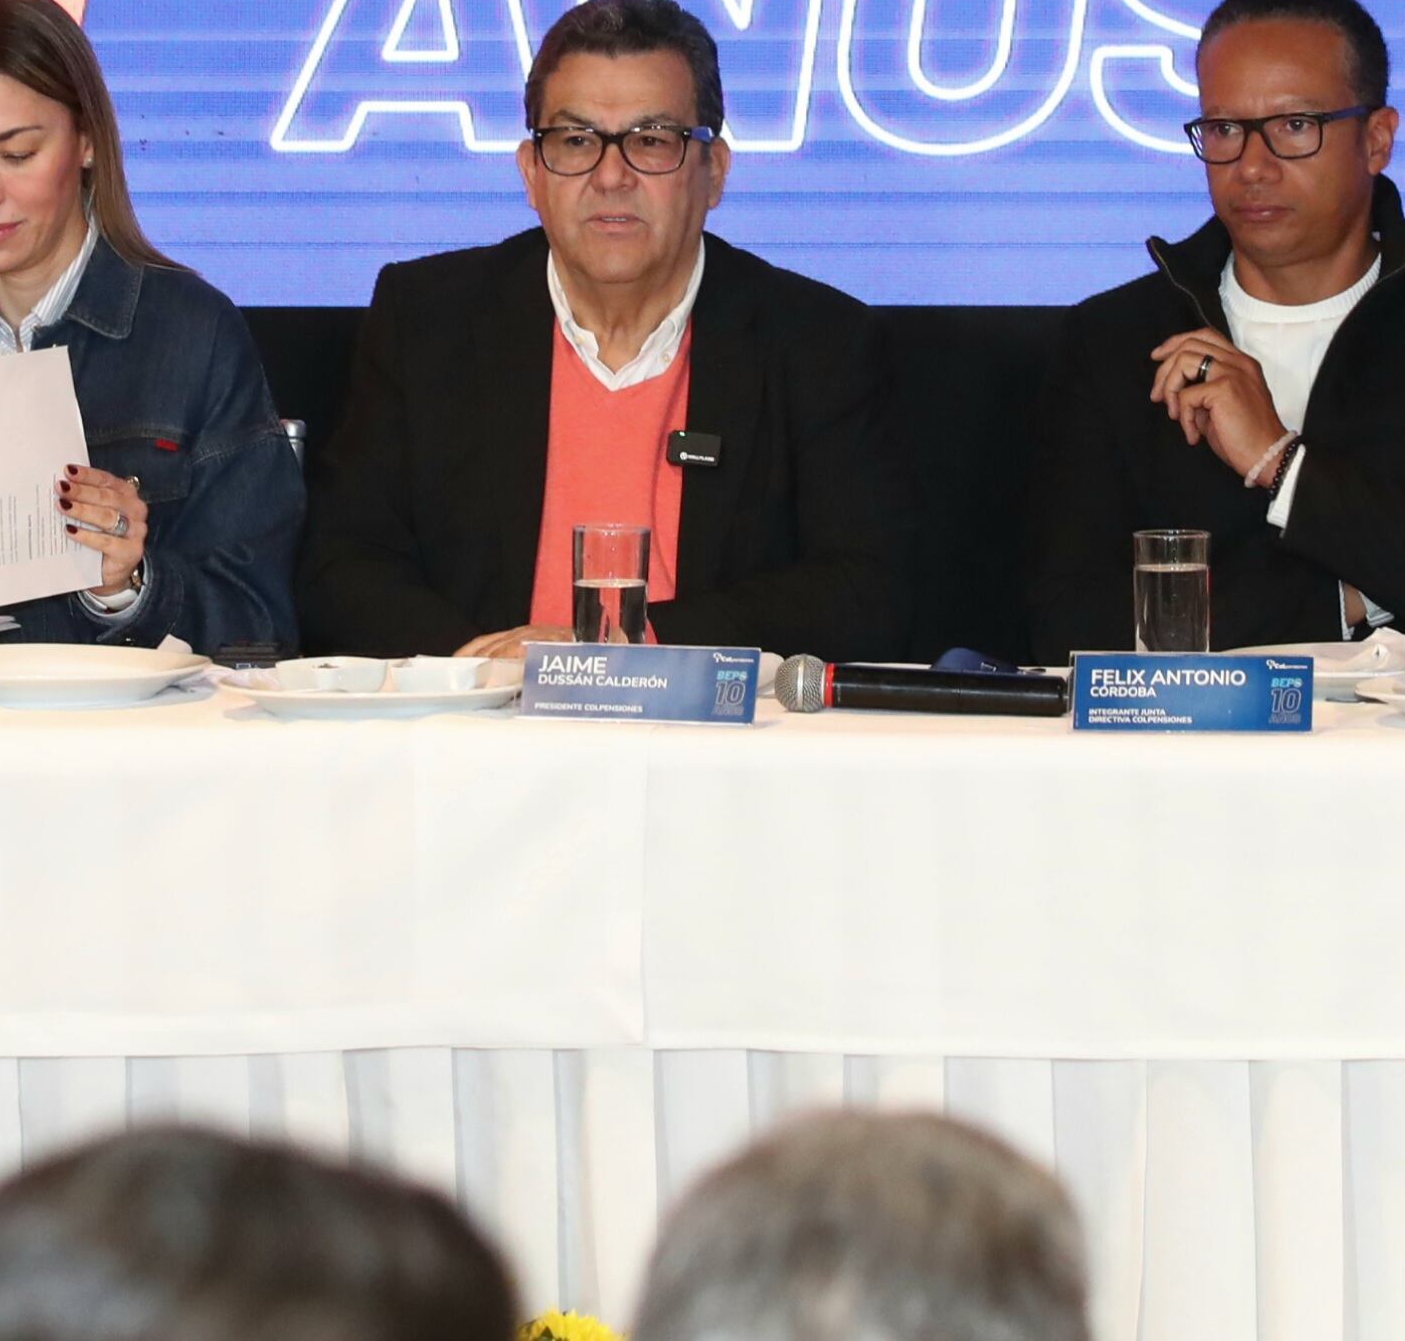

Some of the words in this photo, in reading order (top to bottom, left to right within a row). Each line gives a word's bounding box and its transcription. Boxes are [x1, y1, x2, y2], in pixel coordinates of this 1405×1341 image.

[538, 655, 608, 674] JAIME
[537, 672, 593, 686] DUSSÁN
[596, 673, 668, 689] CALDERÓN
[1091, 669, 1146, 685] FELIX
[1150, 670, 1246, 686] ANTONIO
[715, 681, 746, 706] 10
[1270, 688, 1302, 713] 10
[534, 702, 583, 711] PRESIDENTE
[584, 704, 643, 713] COLPENSIONES
[1088, 708, 1140, 716] INTEGRANTE
[1141, 708, 1166, 716] JUNTA
[1088, 716, 1131, 724] DIRECTIVA
[1132, 716, 1192, 724] COLPENSIONES
